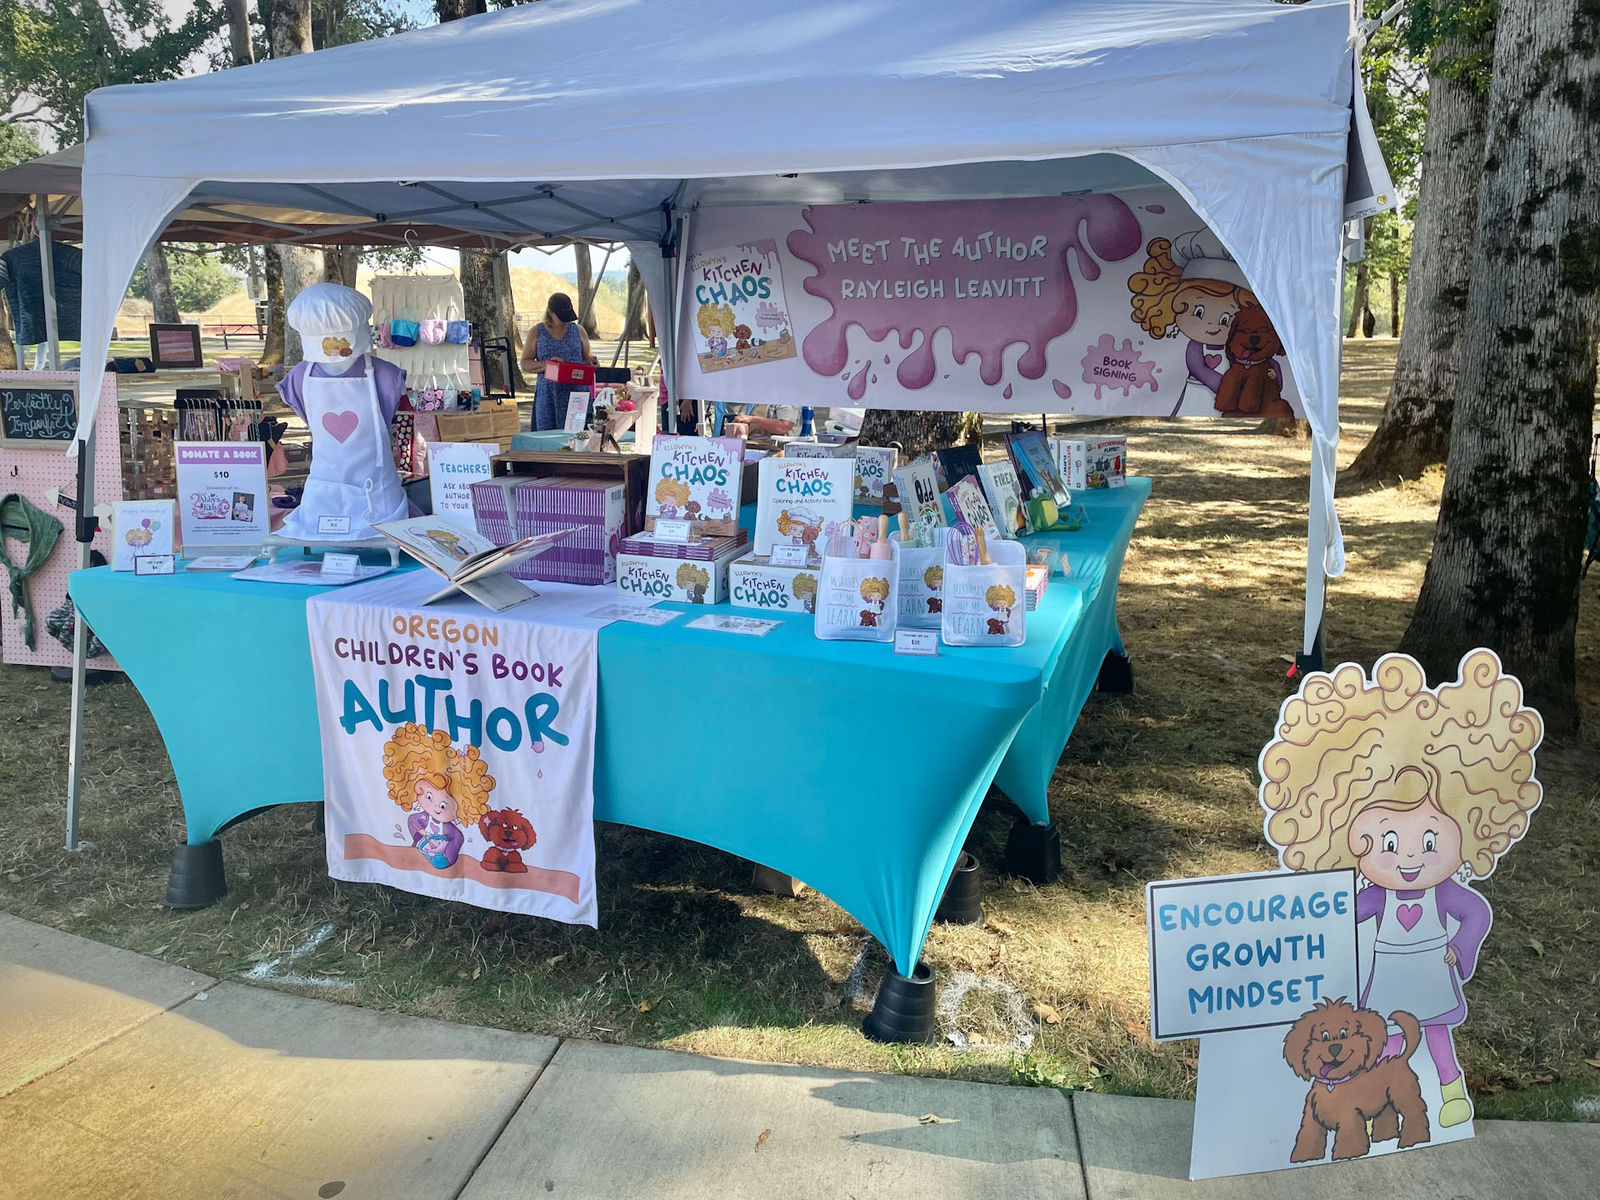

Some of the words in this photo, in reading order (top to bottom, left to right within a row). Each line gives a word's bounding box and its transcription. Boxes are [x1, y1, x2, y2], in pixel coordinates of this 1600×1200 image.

[827, 238, 890, 265] MEET
[900, 236, 943, 266] THE
[952, 231, 1048, 261] AUTHOR
[703, 259, 763, 283] KITCHEN
[695, 275, 772, 306] CHAOS
[841, 279, 945, 299] RAYLEIGH
[954, 276, 1045, 298] LEAVITT
[1103, 355, 1132, 370] BOOK
[1093, 366, 1137, 382] SIGNING
[1, 391, 74, 419] Perfectly
[8, 407, 77, 437] Imperfect
[182, 450, 220, 459] DONATE
[223, 450, 230, 459] A
[233, 450, 258, 459] BOOK
[673, 450, 725, 467] KITCHEN
[213, 471, 230, 479] $10
[440, 463, 490, 474] TEACHERS!
[661, 462, 729, 486] CHAOS
[785, 468, 829, 481] KITCHEN
[443, 482, 456, 490] ASK
[776, 478, 832, 497] CHAOS
[915, 478, 935, 504] Odd
[628, 567, 670, 583] KITCHEN
[742, 577, 785, 593] KITCHEN
[620, 576, 673, 598] CHAOS
[733, 586, 788, 608] CHAOS
[826, 608, 858, 626] LEARN
[952, 616, 985, 635] LEARN
[392, 615, 498, 647] OREGON
[334, 637, 479, 675] CHILDREN'S
[492, 653, 564, 687] BOOK
[340, 674, 570, 752] AUTHOR
[1159, 891, 1349, 932] ENCOURAGE
[1186, 933, 1325, 972] GROWTH
[1188, 974, 1324, 1014] MINDSET
